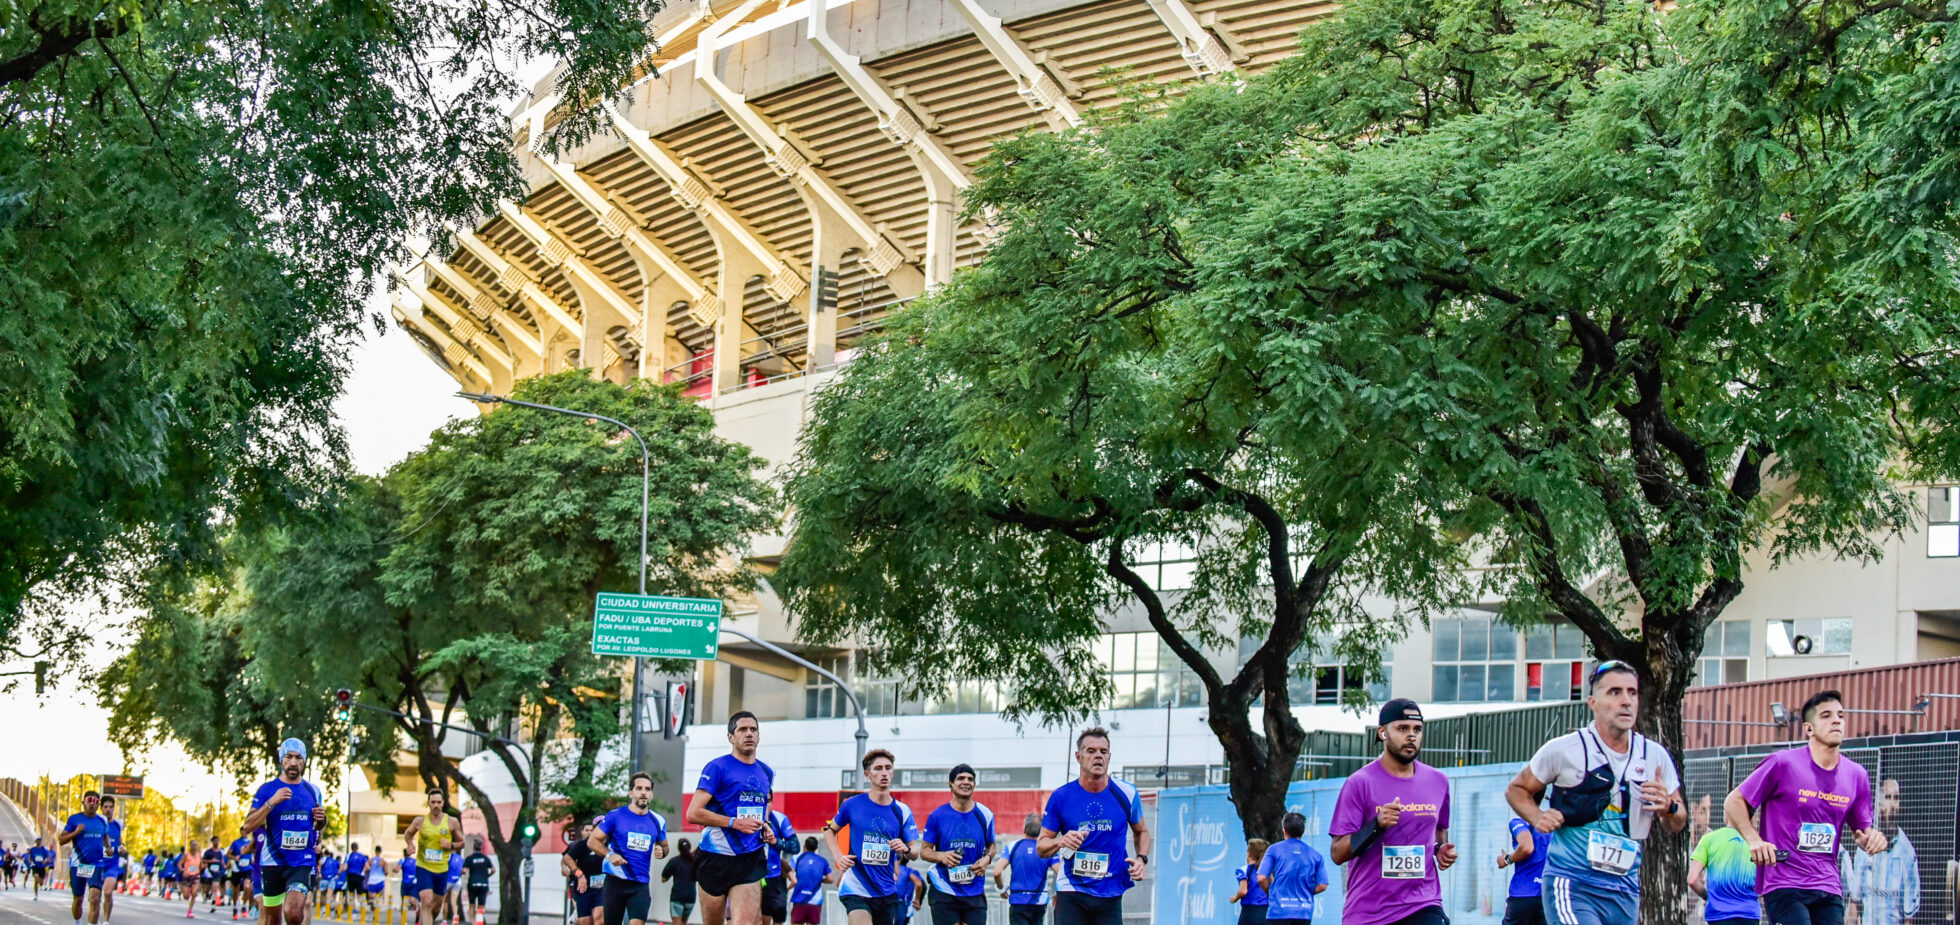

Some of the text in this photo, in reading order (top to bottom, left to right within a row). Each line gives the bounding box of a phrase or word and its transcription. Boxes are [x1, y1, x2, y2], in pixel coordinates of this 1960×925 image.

[601, 598, 717, 612] CIUDAD UNIVERSITARIA
[599, 613, 624, 623] FADU
[632, 616, 651, 624] UBA
[653, 617, 703, 627] DEPORTES
[597, 635, 640, 645] EXACTAS
[1798, 789, 1817, 798] new
[1818, 790, 1850, 804] balance
[1097, 824, 1113, 832] RUN
[285, 837, 305, 845] 1644
[1804, 832, 1831, 845] 1623
[964, 841, 976, 849] RUN
[865, 849, 888, 859] 1620
[1601, 846, 1623, 863] 171
[1081, 860, 1101, 871] 816
[1388, 856, 1421, 870] 1268
[954, 871, 972, 880] 804
